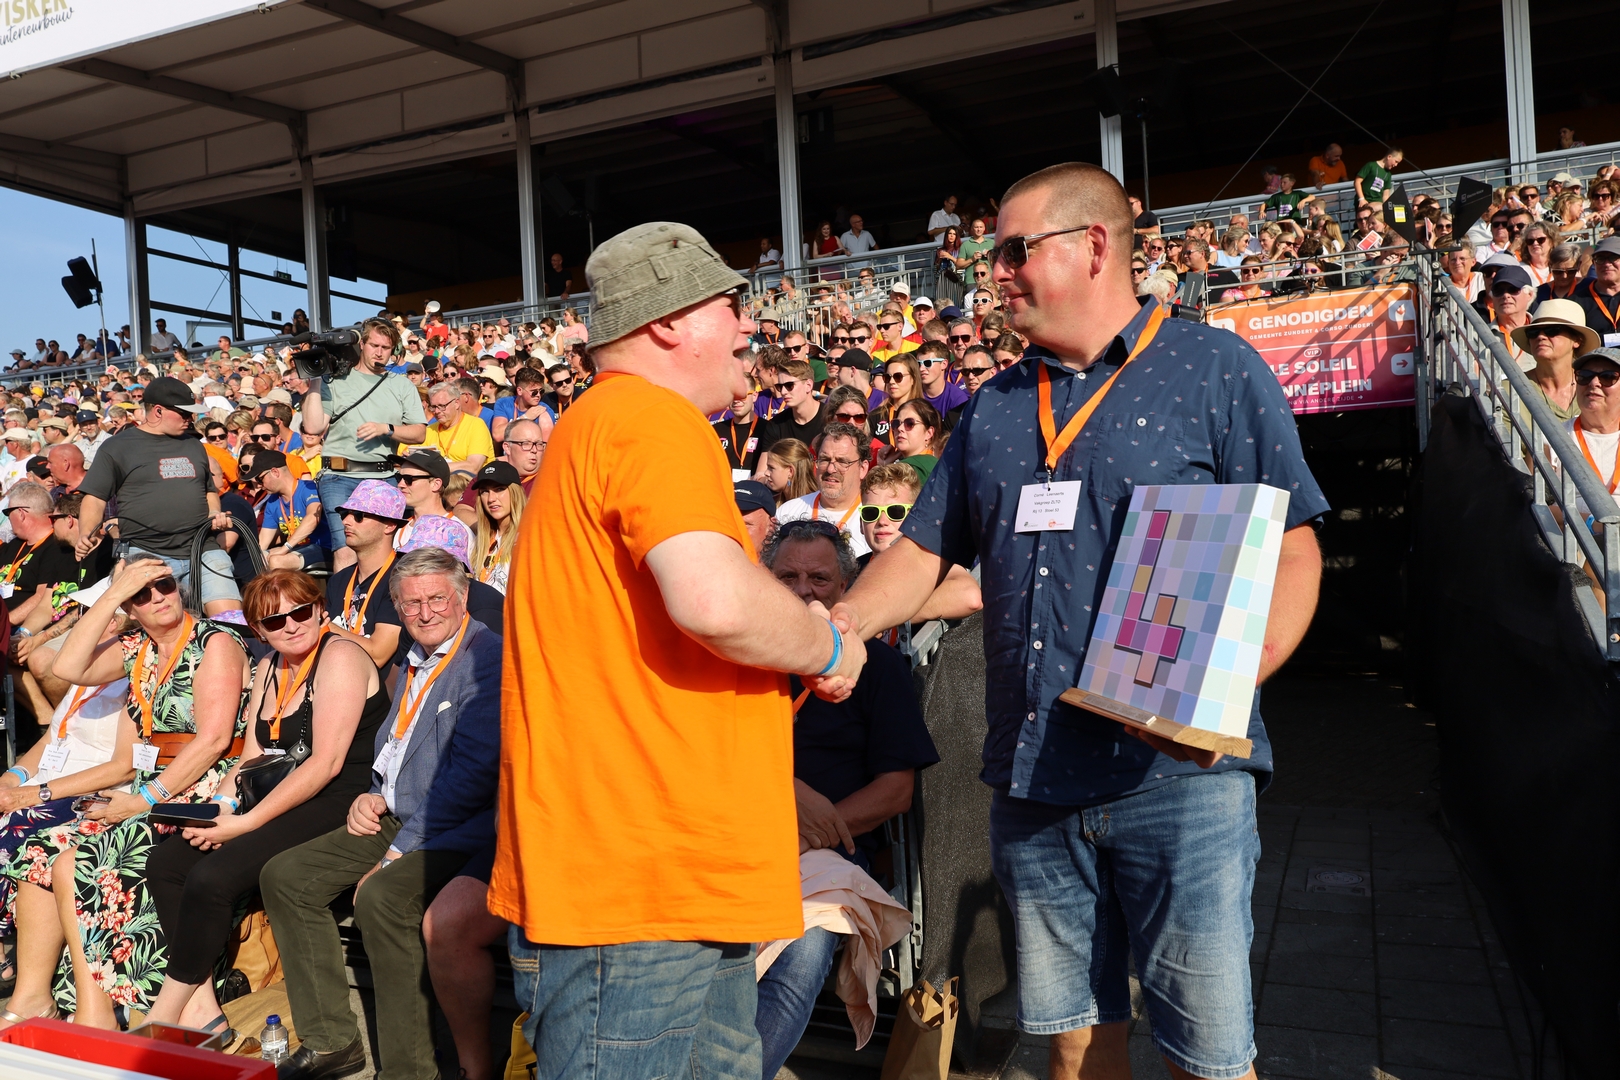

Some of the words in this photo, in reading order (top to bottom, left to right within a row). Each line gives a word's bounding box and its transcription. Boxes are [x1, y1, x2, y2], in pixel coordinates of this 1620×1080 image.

[0, 0, 67, 26] ISKE
[1248, 304, 1373, 330] GENODIGDEN
[1249, 332, 1282, 340] GEMEENTE
[1284, 328, 1313, 336] ZUNDERT
[1320, 325, 1343, 333] CORSO
[1344, 322, 1374, 330] ZUNDERT
[1294, 357, 1357, 374] SOLEIL
[1282, 378, 1373, 398] NNEPLEIN
